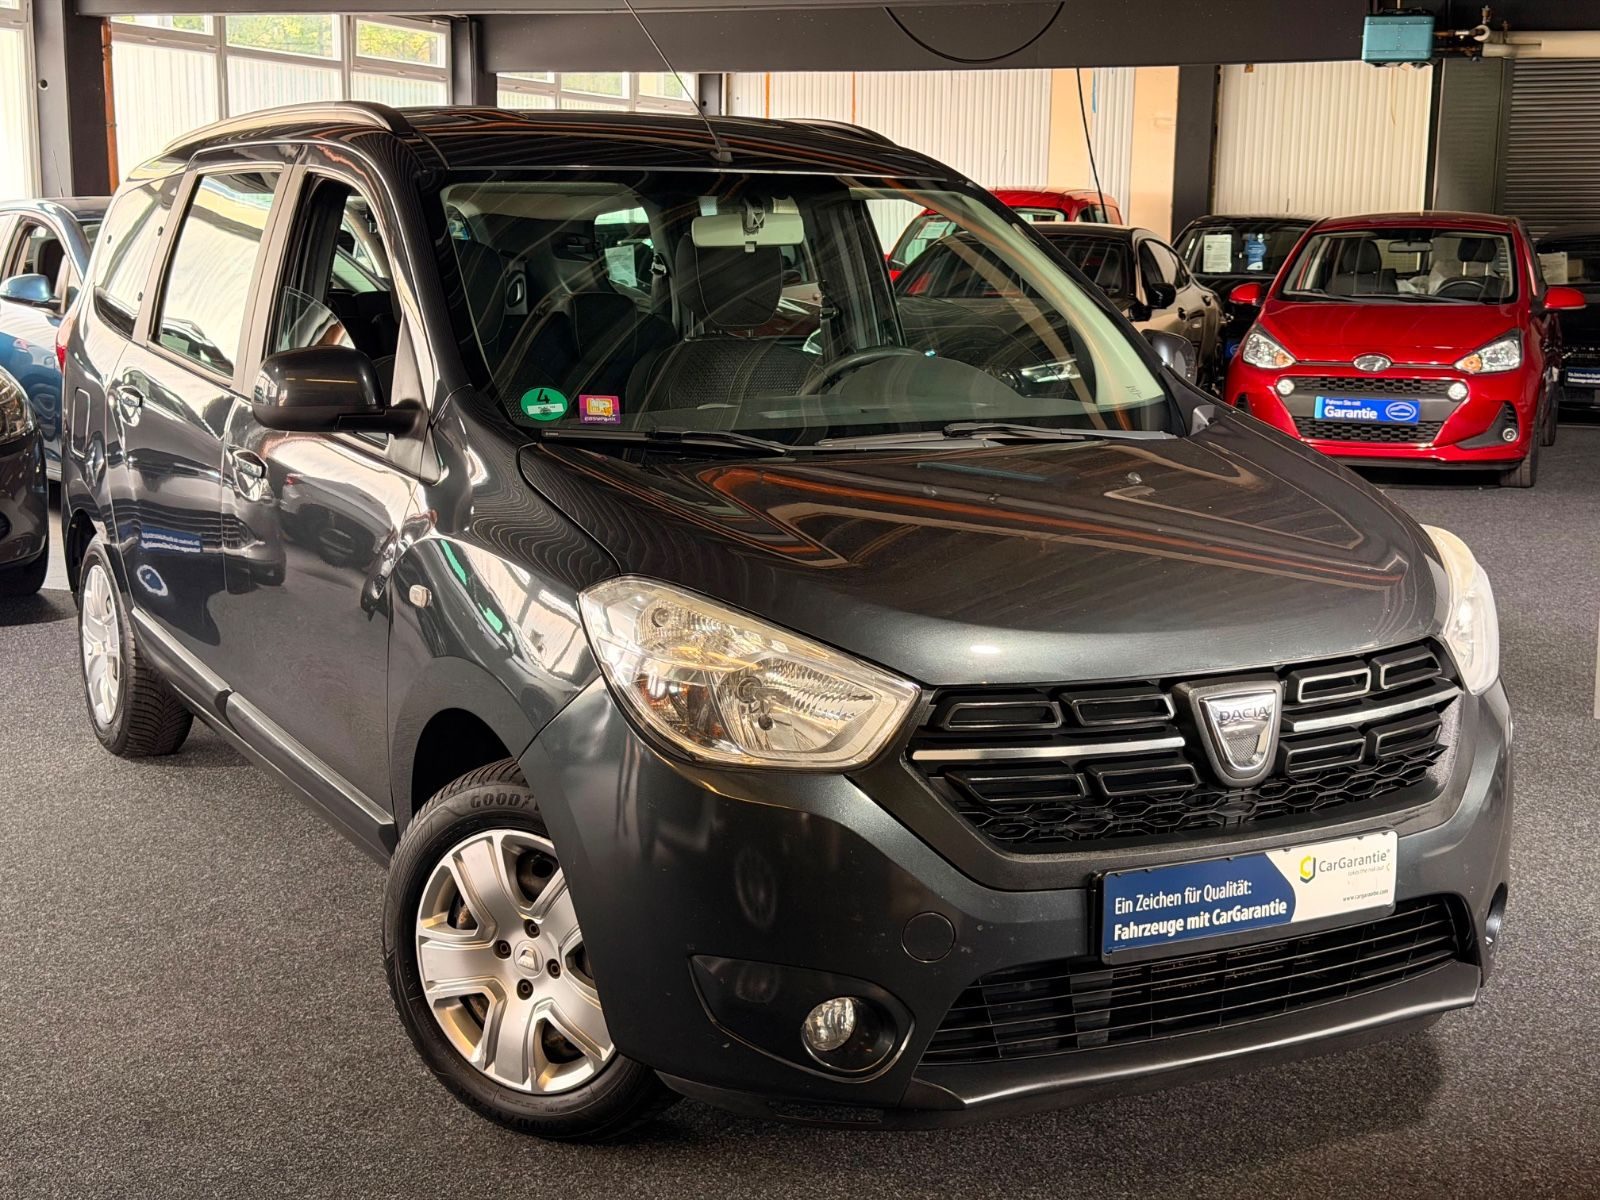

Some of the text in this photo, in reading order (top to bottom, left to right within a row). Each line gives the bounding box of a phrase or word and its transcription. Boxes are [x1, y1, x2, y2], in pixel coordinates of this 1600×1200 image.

[536, 388, 551, 404] 4
[1324, 405, 1378, 419] Garantie
[1219, 706, 1269, 721] DACIA
[1318, 850, 1387, 873] CarGarantie
[1114, 879, 1252, 915] Ein Zeichen für Qualität:
[1114, 898, 1288, 941] Fahrzeuge mit CarGarantie
